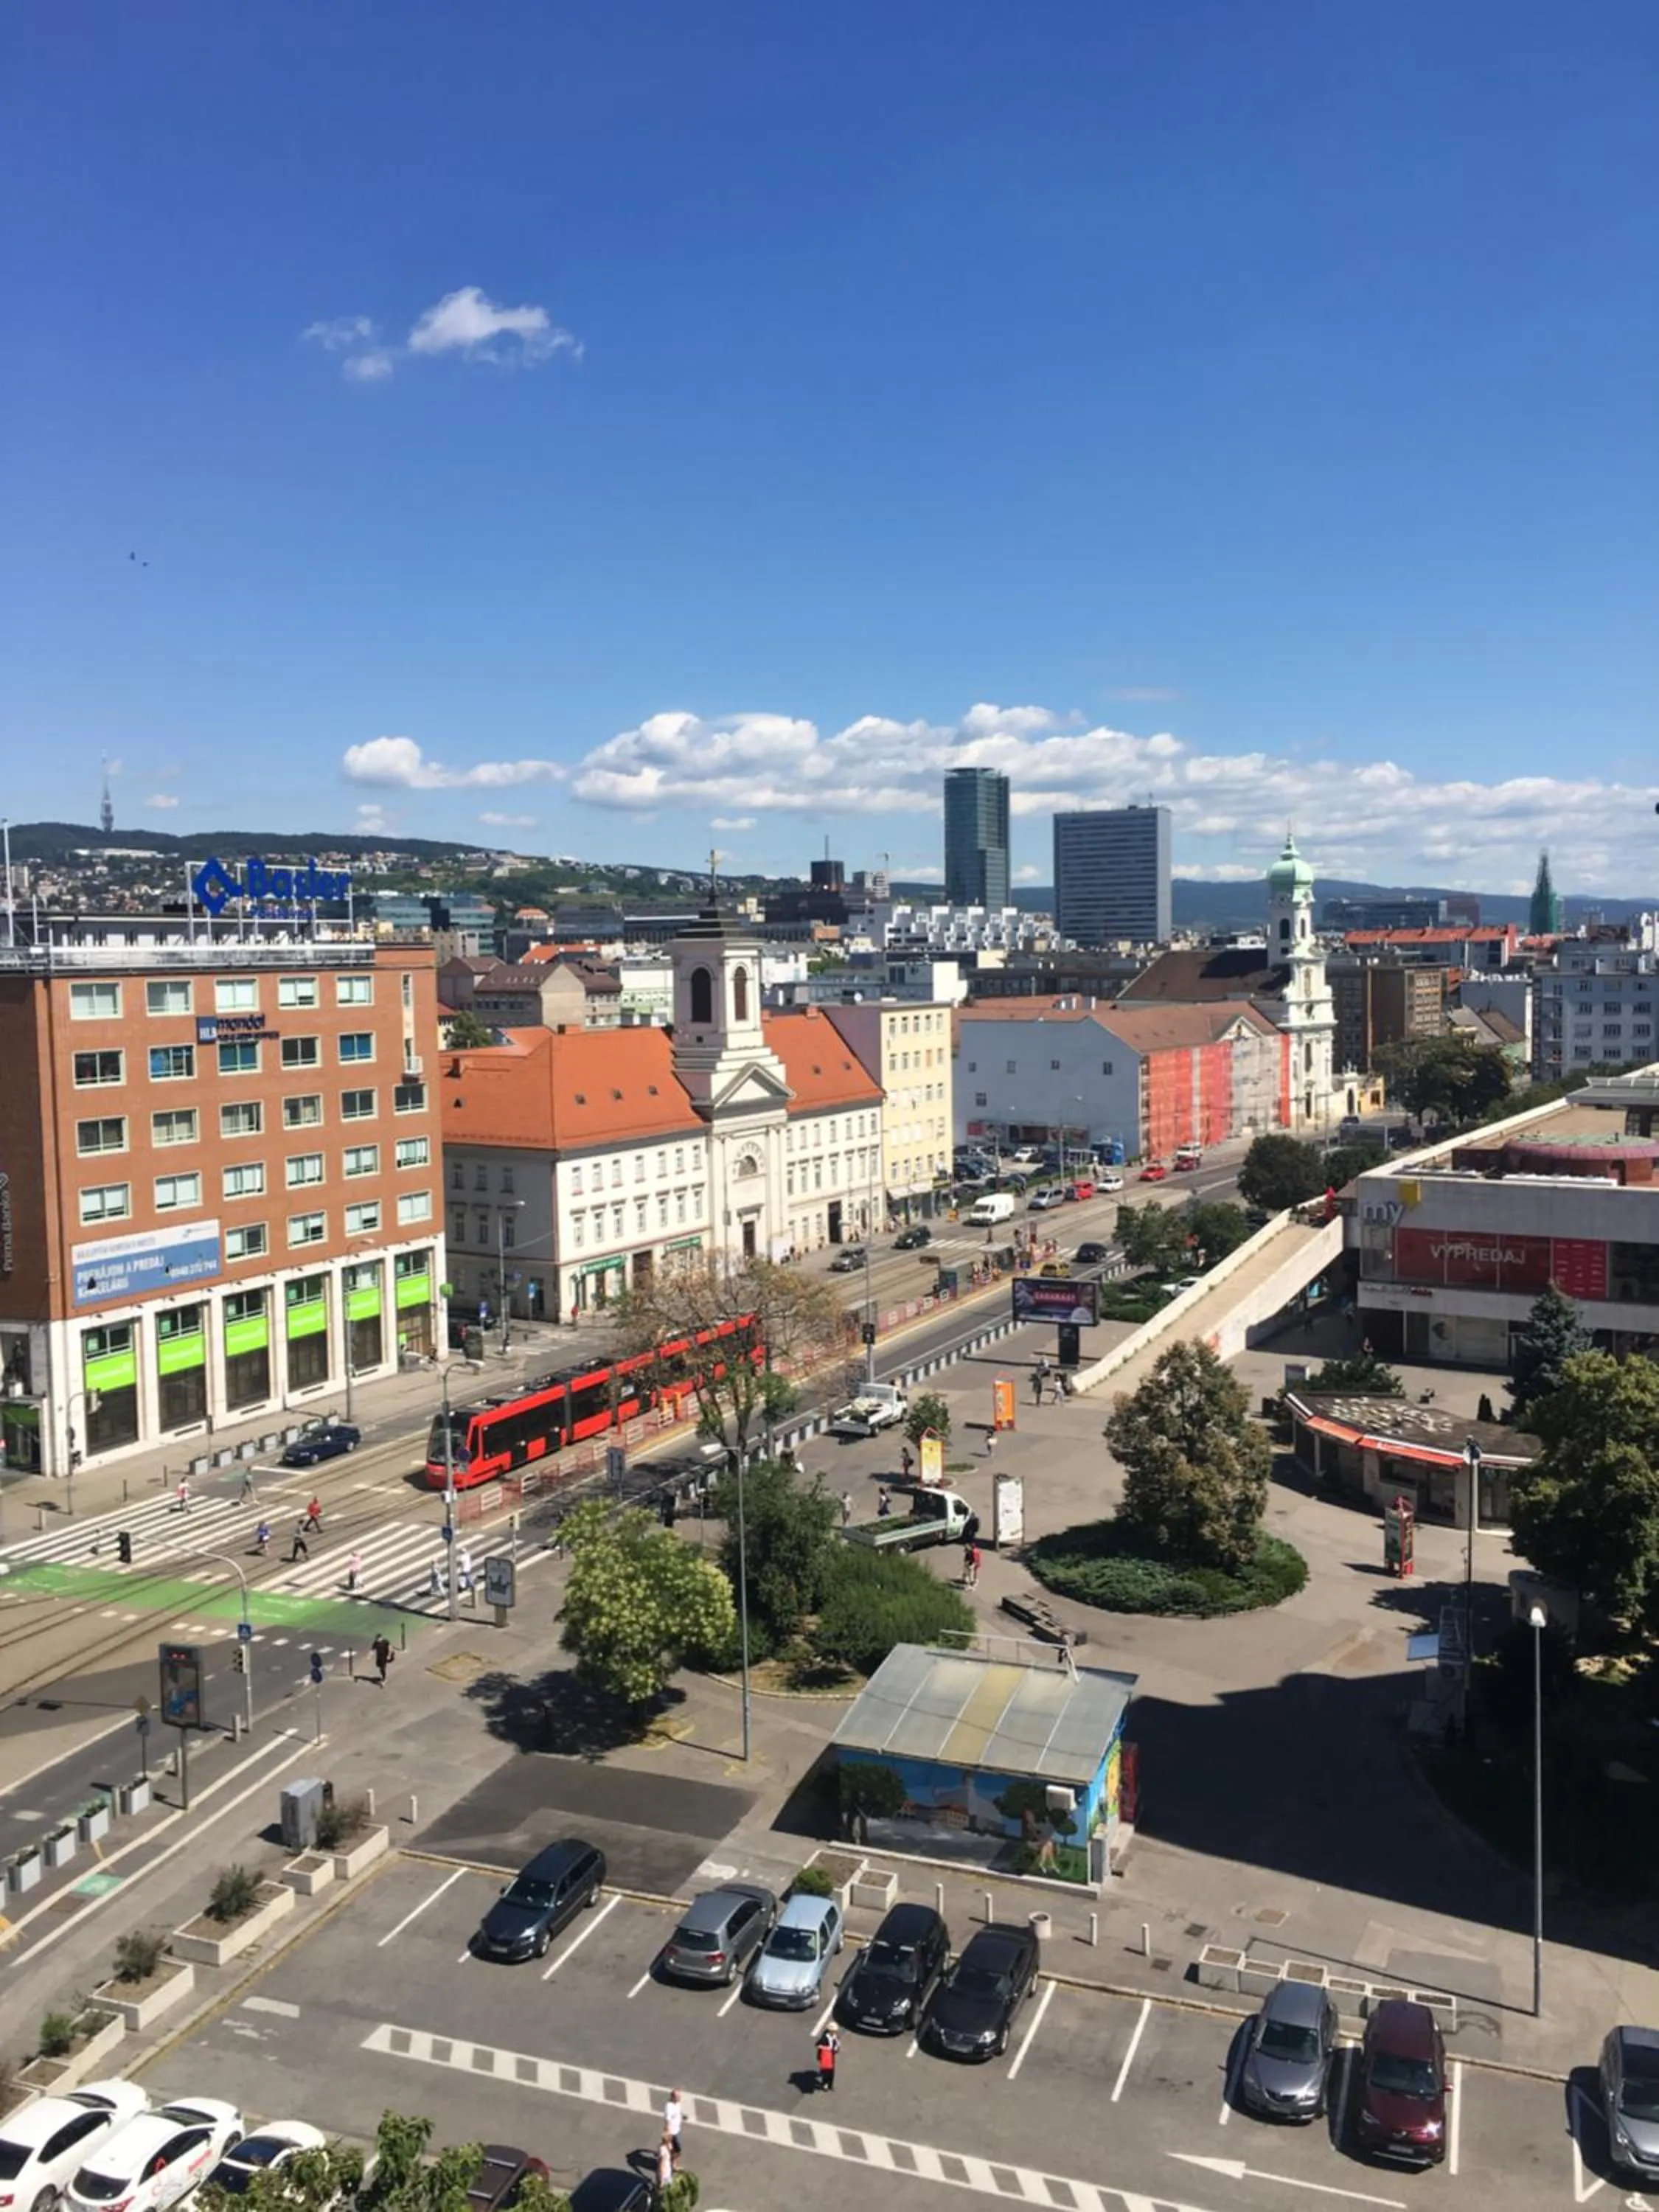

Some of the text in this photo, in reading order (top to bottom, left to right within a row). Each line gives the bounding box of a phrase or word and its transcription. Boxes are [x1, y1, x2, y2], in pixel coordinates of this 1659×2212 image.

[247, 858, 352, 900] Basler
[1365, 1200, 1405, 1225] my
[1430, 1243, 1525, 1265] VYPREDAJ
